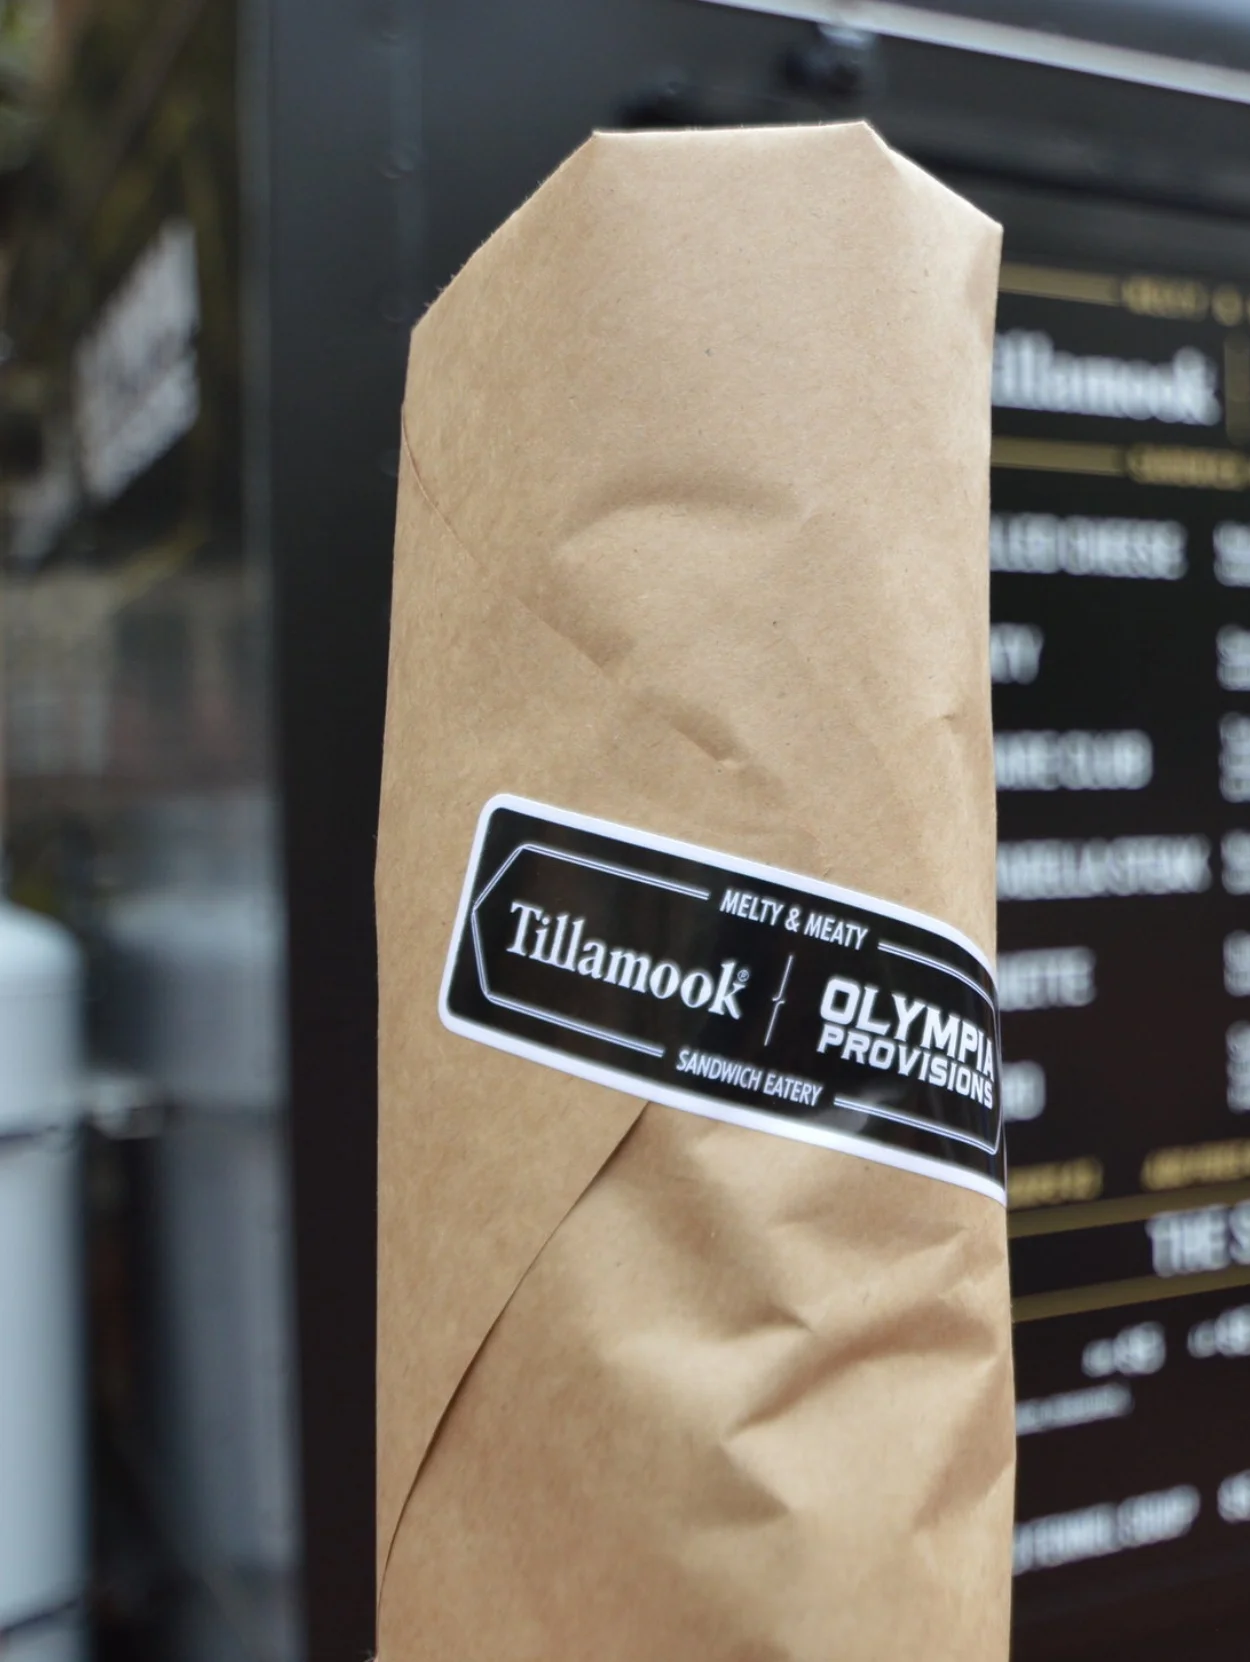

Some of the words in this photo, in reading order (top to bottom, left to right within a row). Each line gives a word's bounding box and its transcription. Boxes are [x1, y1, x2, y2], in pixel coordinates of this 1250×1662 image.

[506, 902, 747, 1019] Tillamook
[720, 889, 784, 926] MELTY
[785, 907, 800, 932] &
[804, 913, 868, 950] MEATY
[817, 1024, 993, 1110] PROVISIONS
[820, 978, 994, 1082] OLYMPIA
[676, 1051, 762, 1092] SANDWICH
[763, 1073, 823, 1106] EATERY
